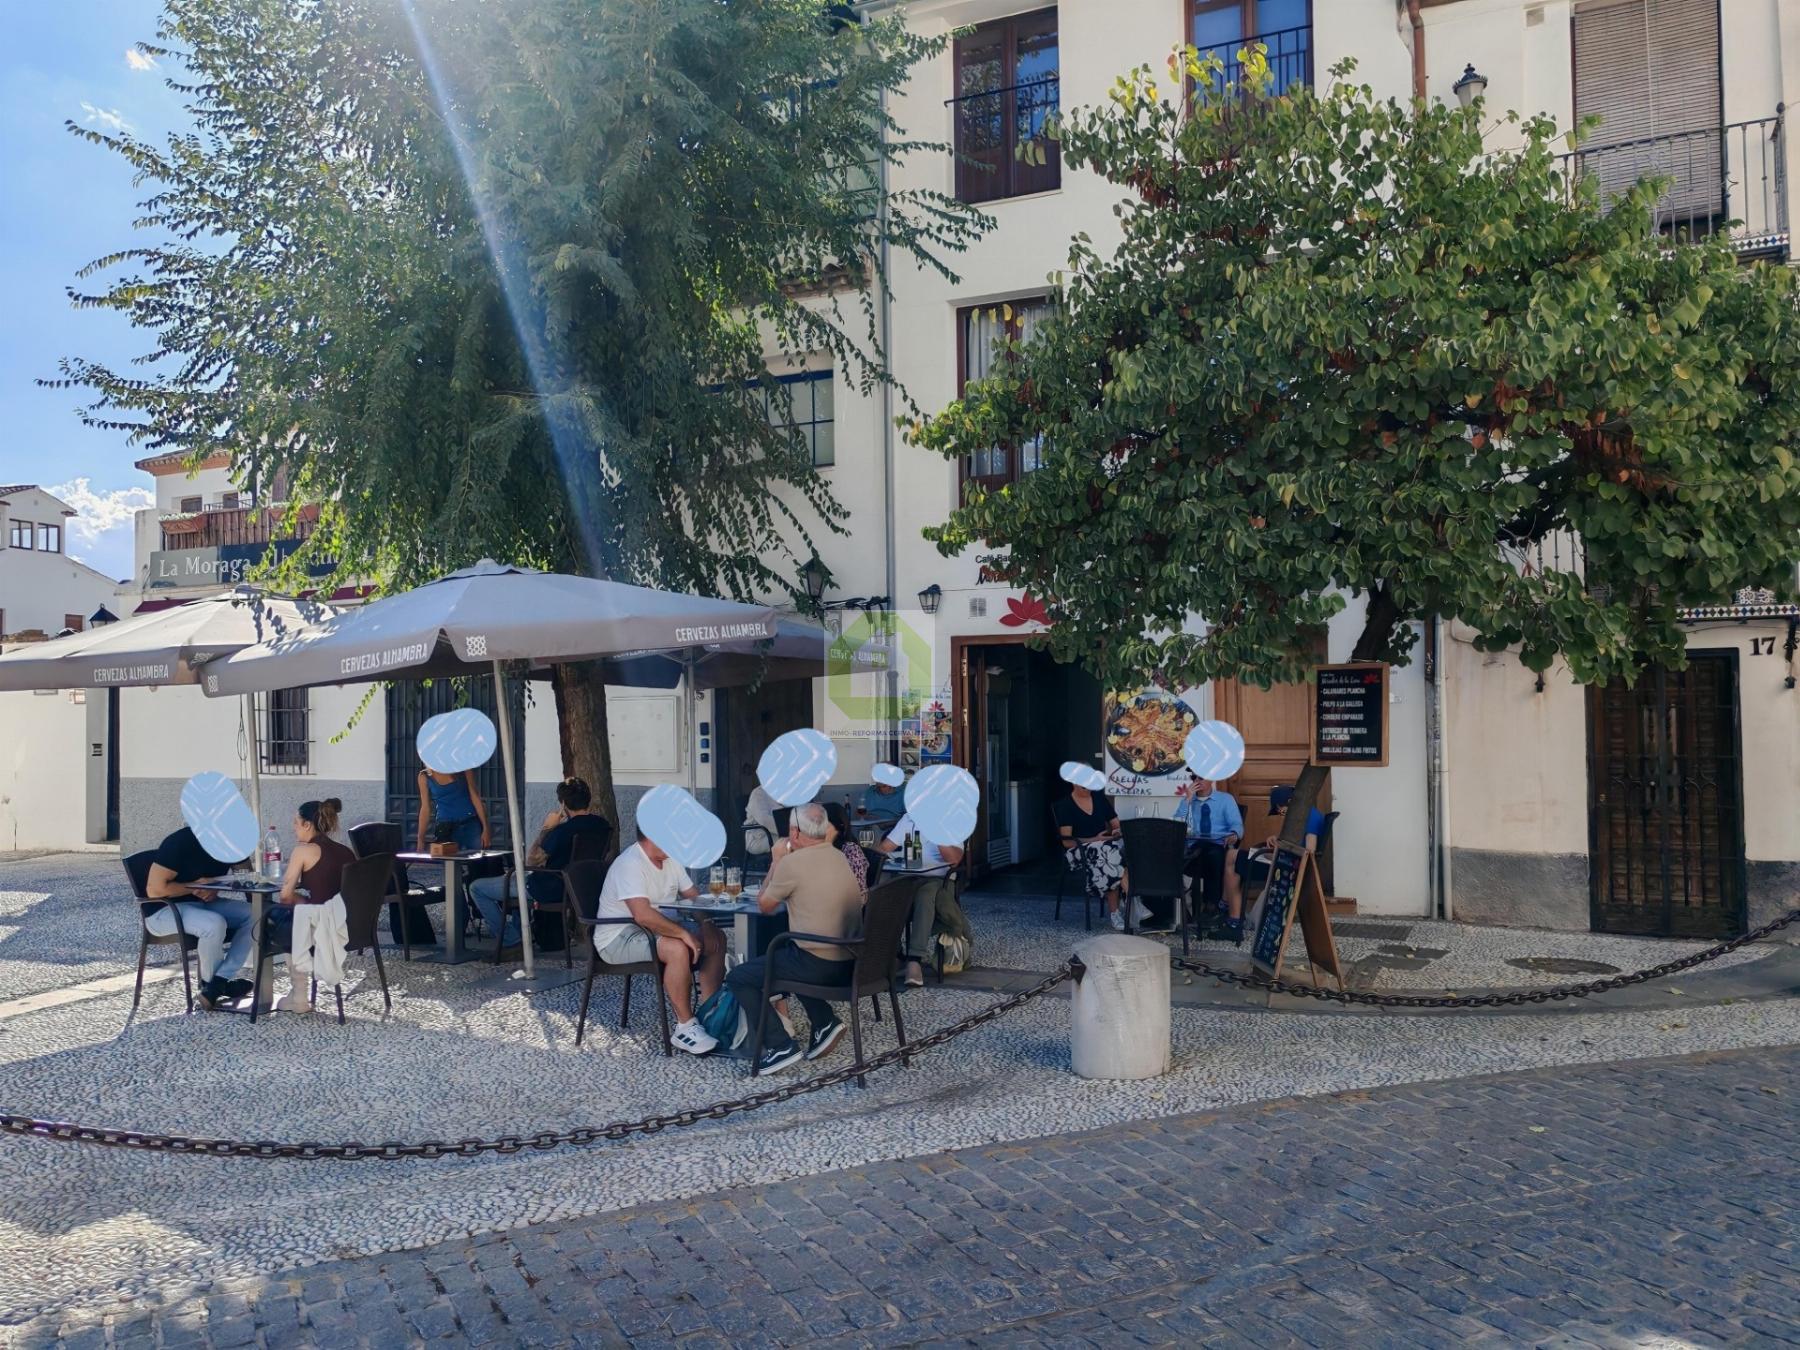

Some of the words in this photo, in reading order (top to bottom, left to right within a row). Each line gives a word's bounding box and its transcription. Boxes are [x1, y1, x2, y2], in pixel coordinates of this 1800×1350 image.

[159, 558, 178, 577] La
[185, 555, 251, 583] Moraga
[674, 626, 720, 643] CERVEZAS
[721, 622, 768, 639] ALHAMBRA
[1749, 636, 1776, 656] 17
[340, 652, 380, 674] CERVEZAS
[381, 643, 428, 666] ALHAMBRA
[93, 667, 128, 682] CERVEZAS
[129, 664, 169, 680] ALHAMBRA
